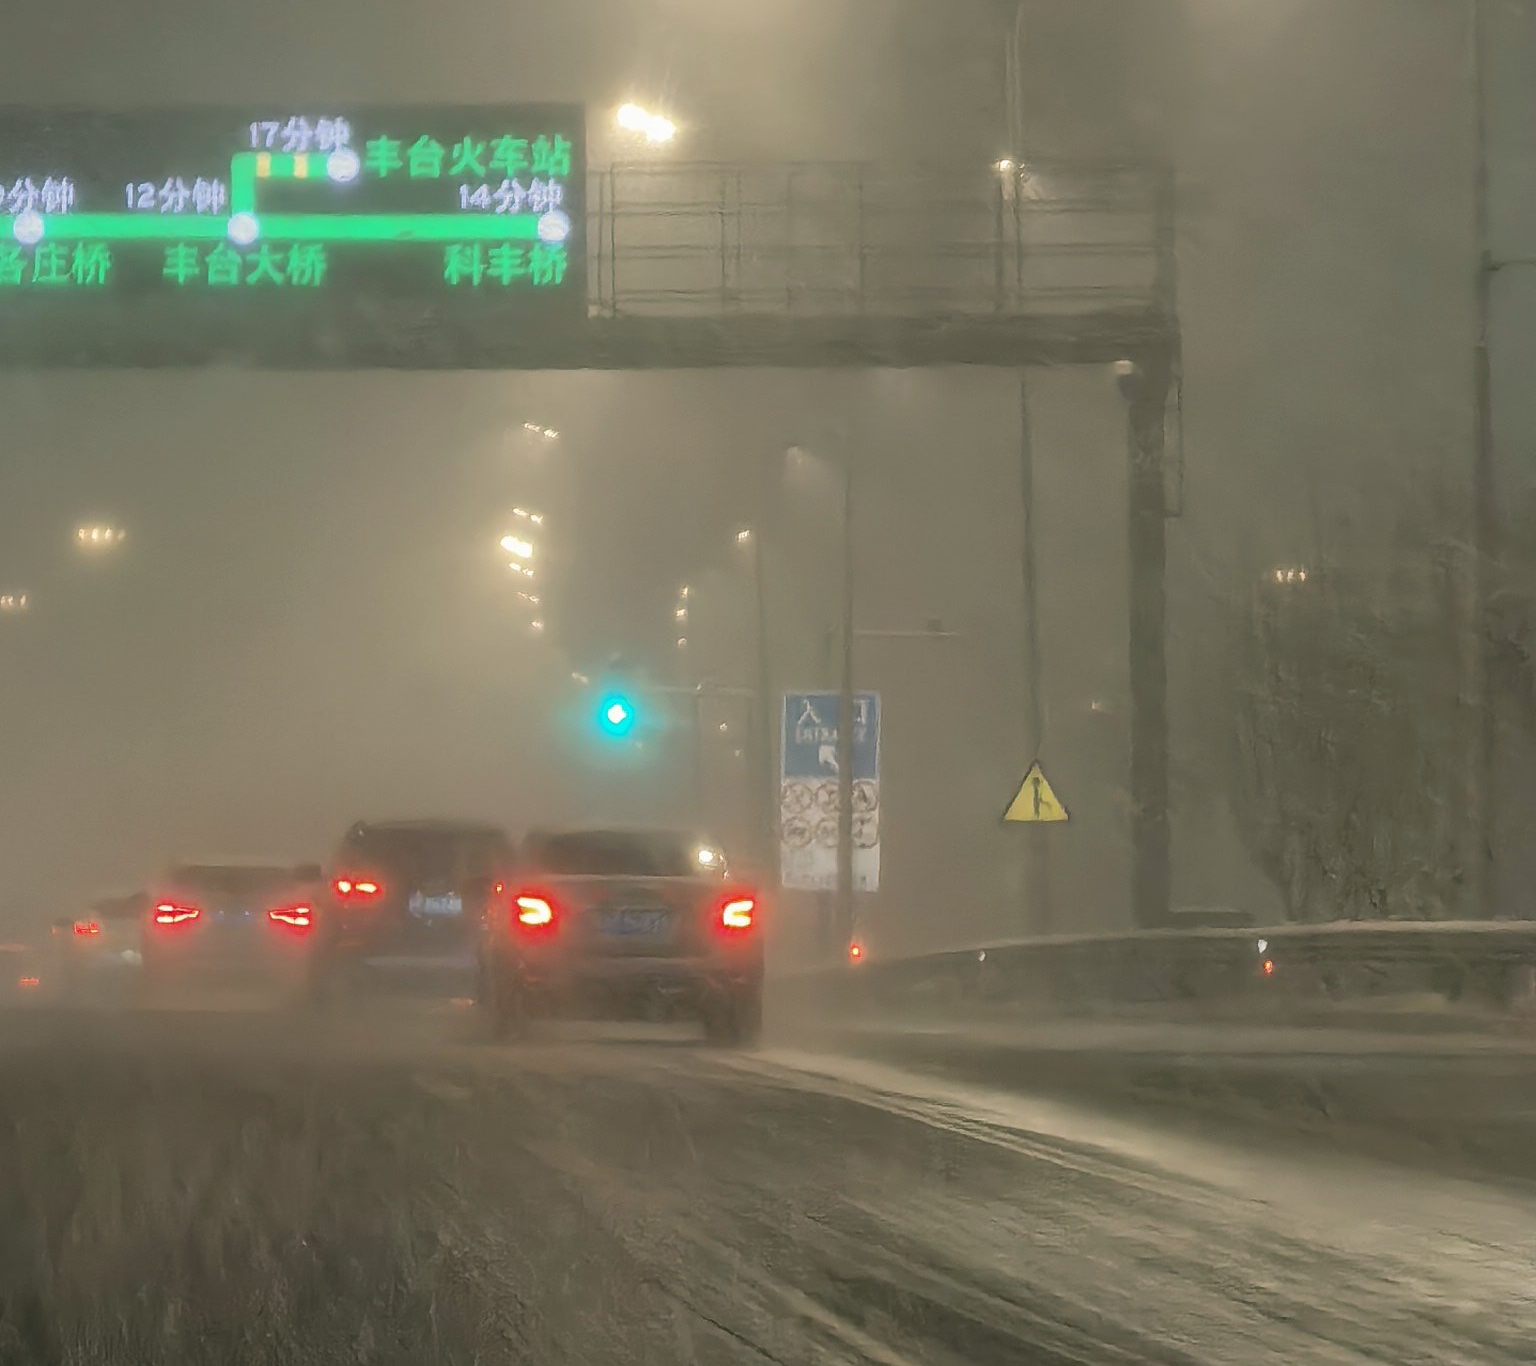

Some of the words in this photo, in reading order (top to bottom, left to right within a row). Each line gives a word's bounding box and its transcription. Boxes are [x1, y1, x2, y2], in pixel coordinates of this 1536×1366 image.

[249, 115, 351, 152] 17分钟
[366, 134, 571, 178] 丰台火车站
[125, 177, 226, 215] 12分钟
[459, 178, 563, 214] 14分钟
[163, 243, 327, 286] 丰台大桥
[444, 243, 568, 286] 科丰桥
